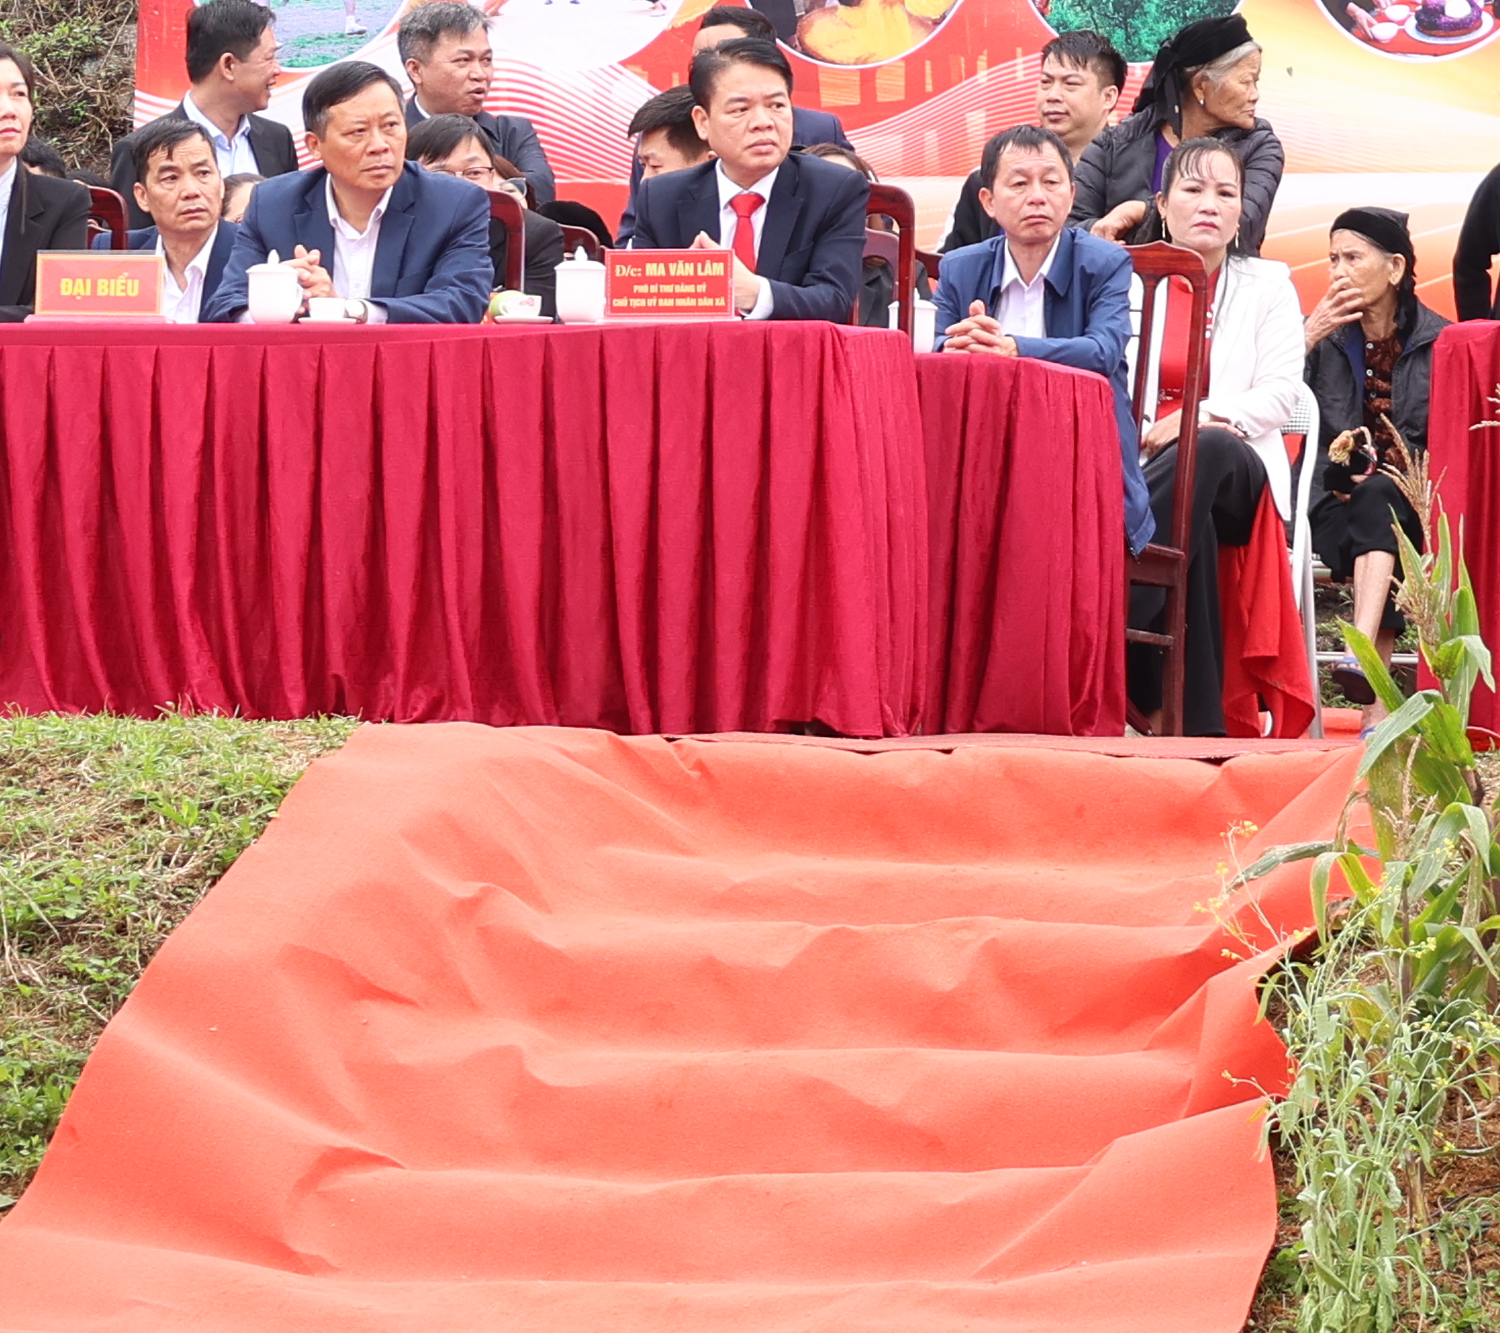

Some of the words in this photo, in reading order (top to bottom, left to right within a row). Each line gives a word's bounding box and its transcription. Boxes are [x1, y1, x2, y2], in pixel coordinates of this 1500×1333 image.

[615, 264, 642, 277] Đ/c:
[645, 263, 666, 276] MA
[668, 260, 694, 276] VĂN
[697, 259, 725, 276] LÂM
[60, 278, 91, 300] ĐẠI
[97, 272, 140, 297] BIỂU
